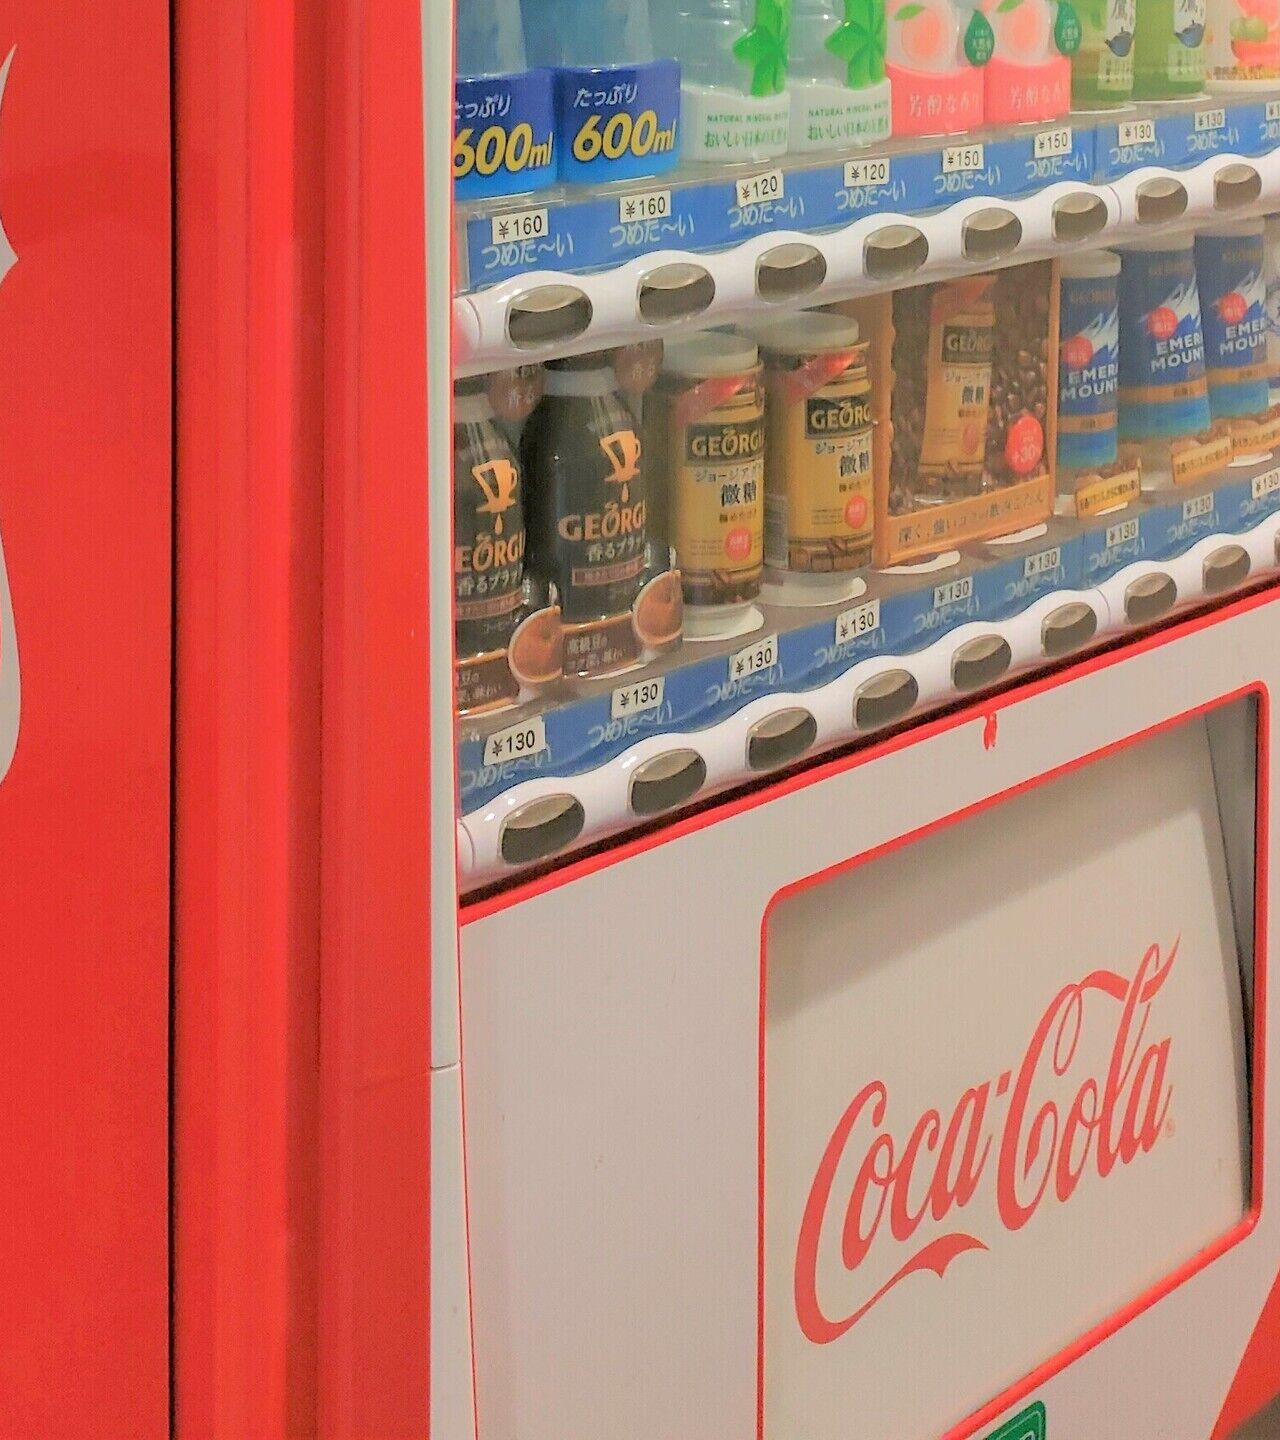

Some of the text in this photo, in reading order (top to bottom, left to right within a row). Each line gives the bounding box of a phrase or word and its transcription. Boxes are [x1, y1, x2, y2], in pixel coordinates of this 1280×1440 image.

[573, 83, 639, 109] たっぷり
[808, 107, 844, 117] NATURAL
[1198, 111, 1223, 128] ¥130
[573, 110, 677, 162] 600ml
[1038, 133, 1069, 150] ¥150
[1124, 123, 1152, 140] ¥130
[454, 122, 553, 177] 600ml
[947, 150, 980, 167] ¥150
[851, 163, 886, 181] ¥120
[741, 175, 779, 199] ¥120
[625, 196, 666, 219] ¥160
[498, 215, 543, 239] ¥160
[1255, 473, 1279, 494] ¥130
[1109, 521, 1136, 543] ¥130
[1028, 550, 1058, 572] ¥130
[938, 579, 970, 603] ¥130
[839, 610, 875, 638] ¥130
[734, 647, 773, 675] ¥130
[619, 683, 659, 710] ¥130
[492, 729, 536, 757] ¥130
[793, 933, 1180, 1344] Coca-Cola
